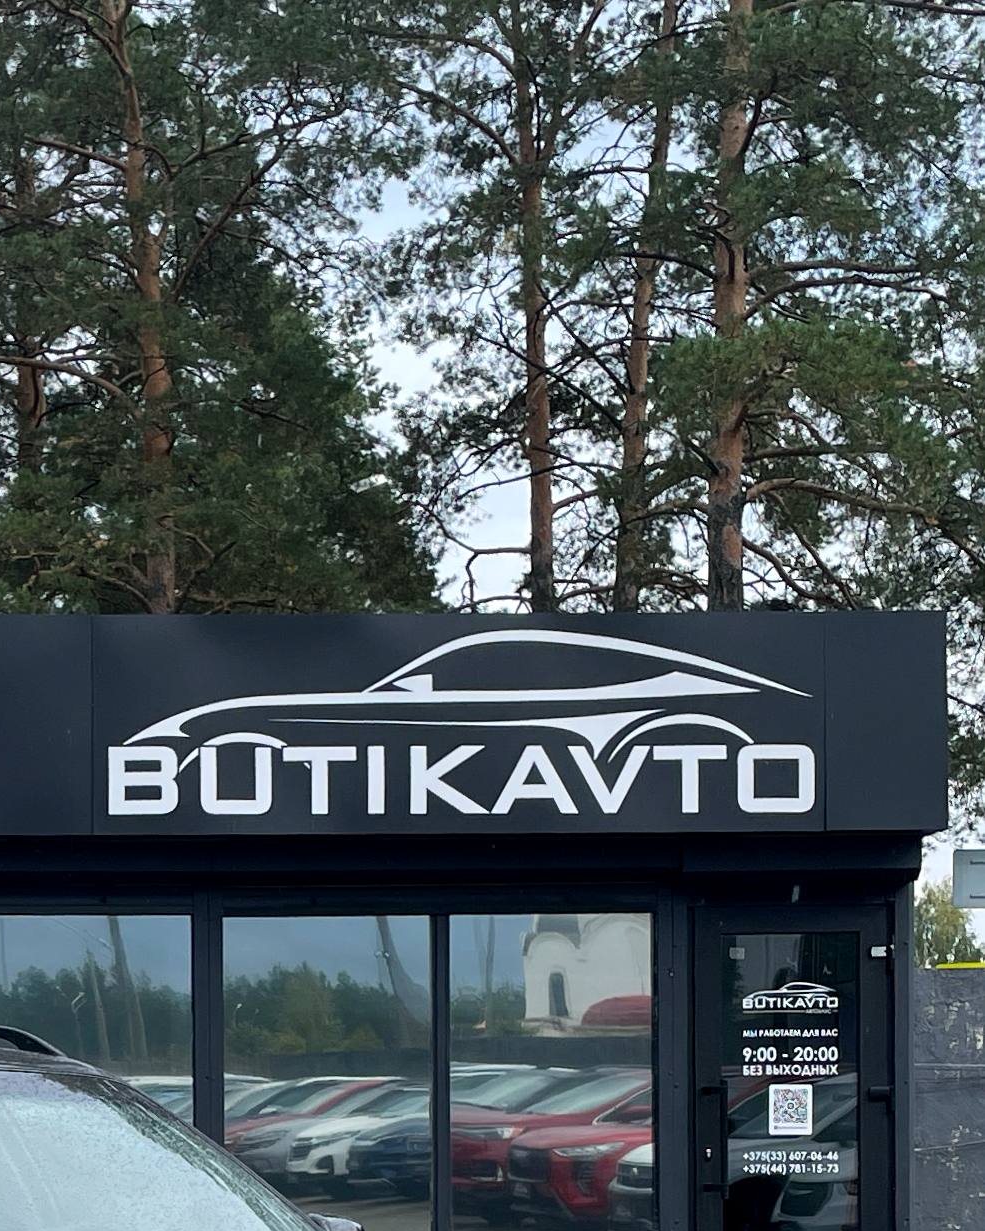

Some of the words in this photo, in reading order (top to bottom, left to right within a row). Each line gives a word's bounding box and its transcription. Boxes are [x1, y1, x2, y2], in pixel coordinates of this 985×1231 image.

[107, 743, 816, 815] BUTIKAVTO
[742, 996, 839, 1009] BUTIKAVTO
[742, 1029, 758, 1038] МЫ
[758, 1029, 801, 1038] РАБОТАЕМ
[801, 1029, 820, 1038] ДЛЯ
[820, 1028, 839, 1038] ВАС
[742, 1046, 777, 1062] 9:00
[792, 1046, 839, 1062] 20:00
[742, 1064, 763, 1076] БЕЗ
[765, 1064, 839, 1077] ВЫХОДНЫХ
[742, 1150, 787, 1162] +375(33)
[788, 1150, 839, 1161] 607-06-46
[742, 1163, 787, 1176] +375(44)
[788, 1163, 839, 1174] 781-15-73
